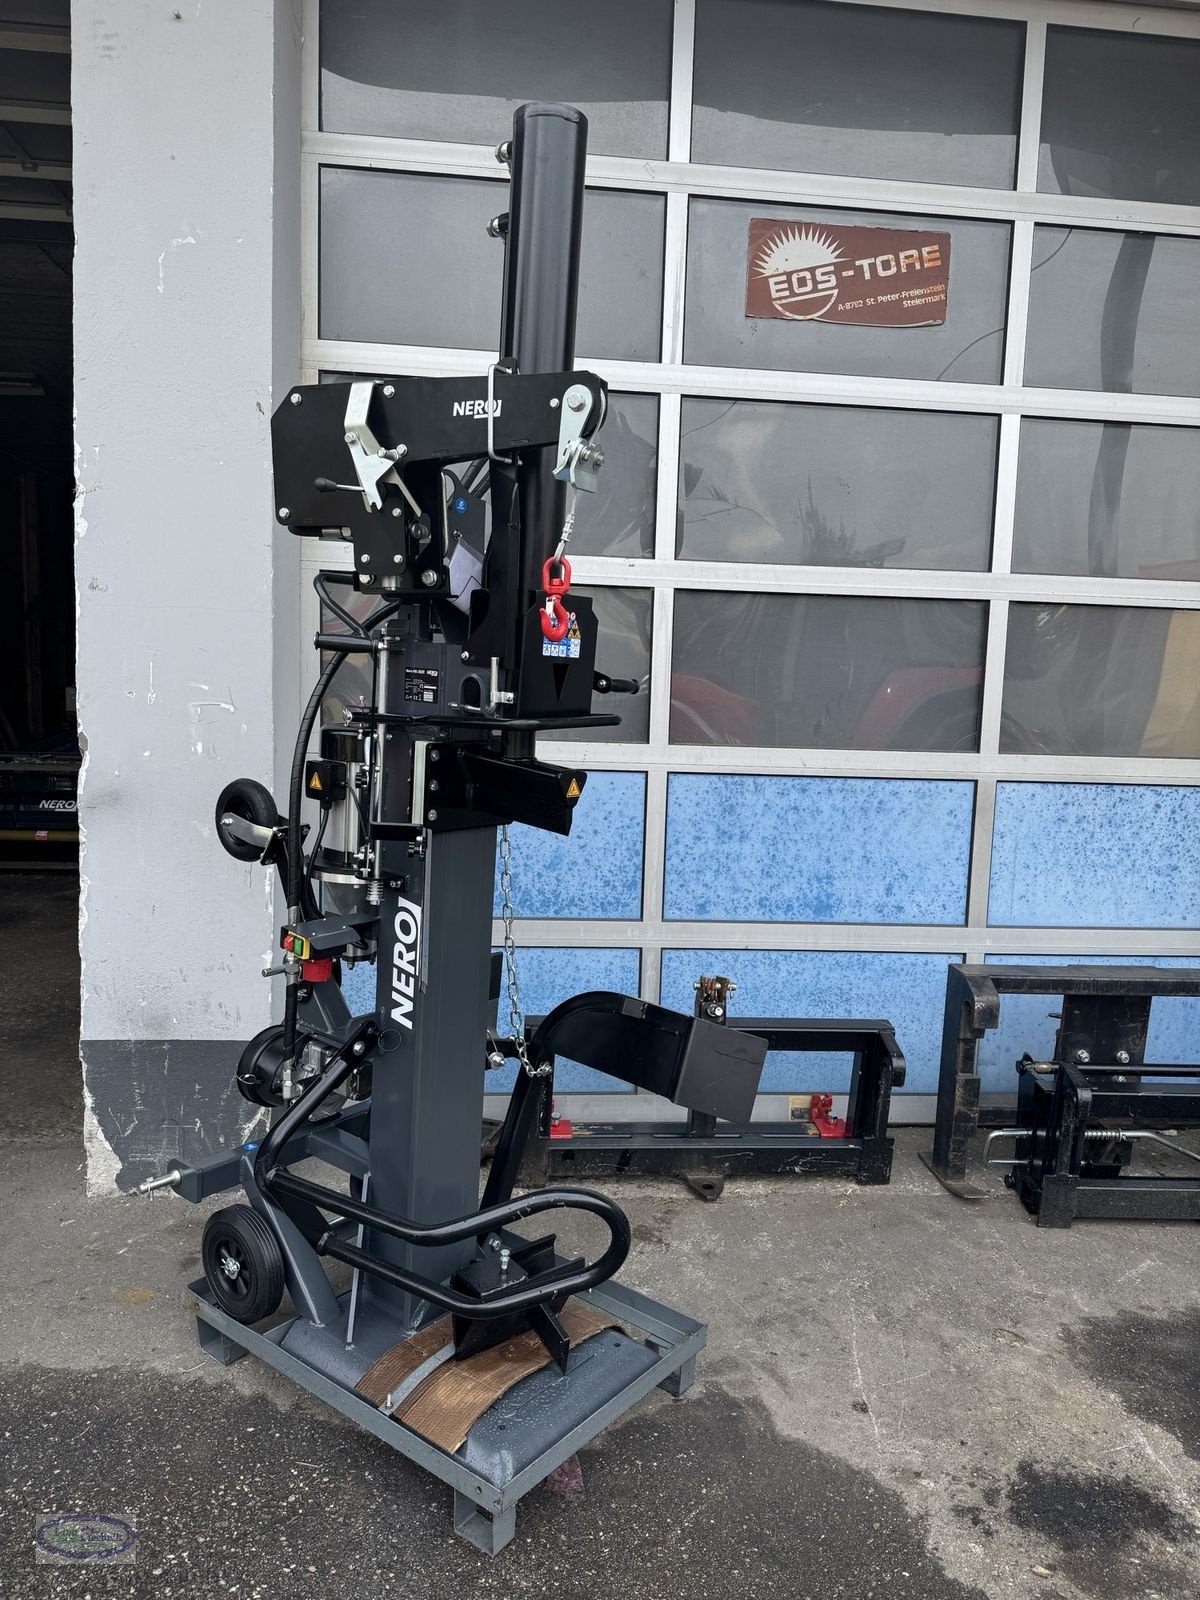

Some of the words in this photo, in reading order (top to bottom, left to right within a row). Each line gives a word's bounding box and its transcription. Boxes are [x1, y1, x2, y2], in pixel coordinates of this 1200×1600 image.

[768, 244, 942, 299] EOS-TORE
[877, 283, 946, 304] Peter-Freienstein
[902, 294, 946, 308] Steiermark
[452, 399, 501, 418] NERO
[38, 799, 76, 811] NERO
[390, 904, 420, 1030] NERO
